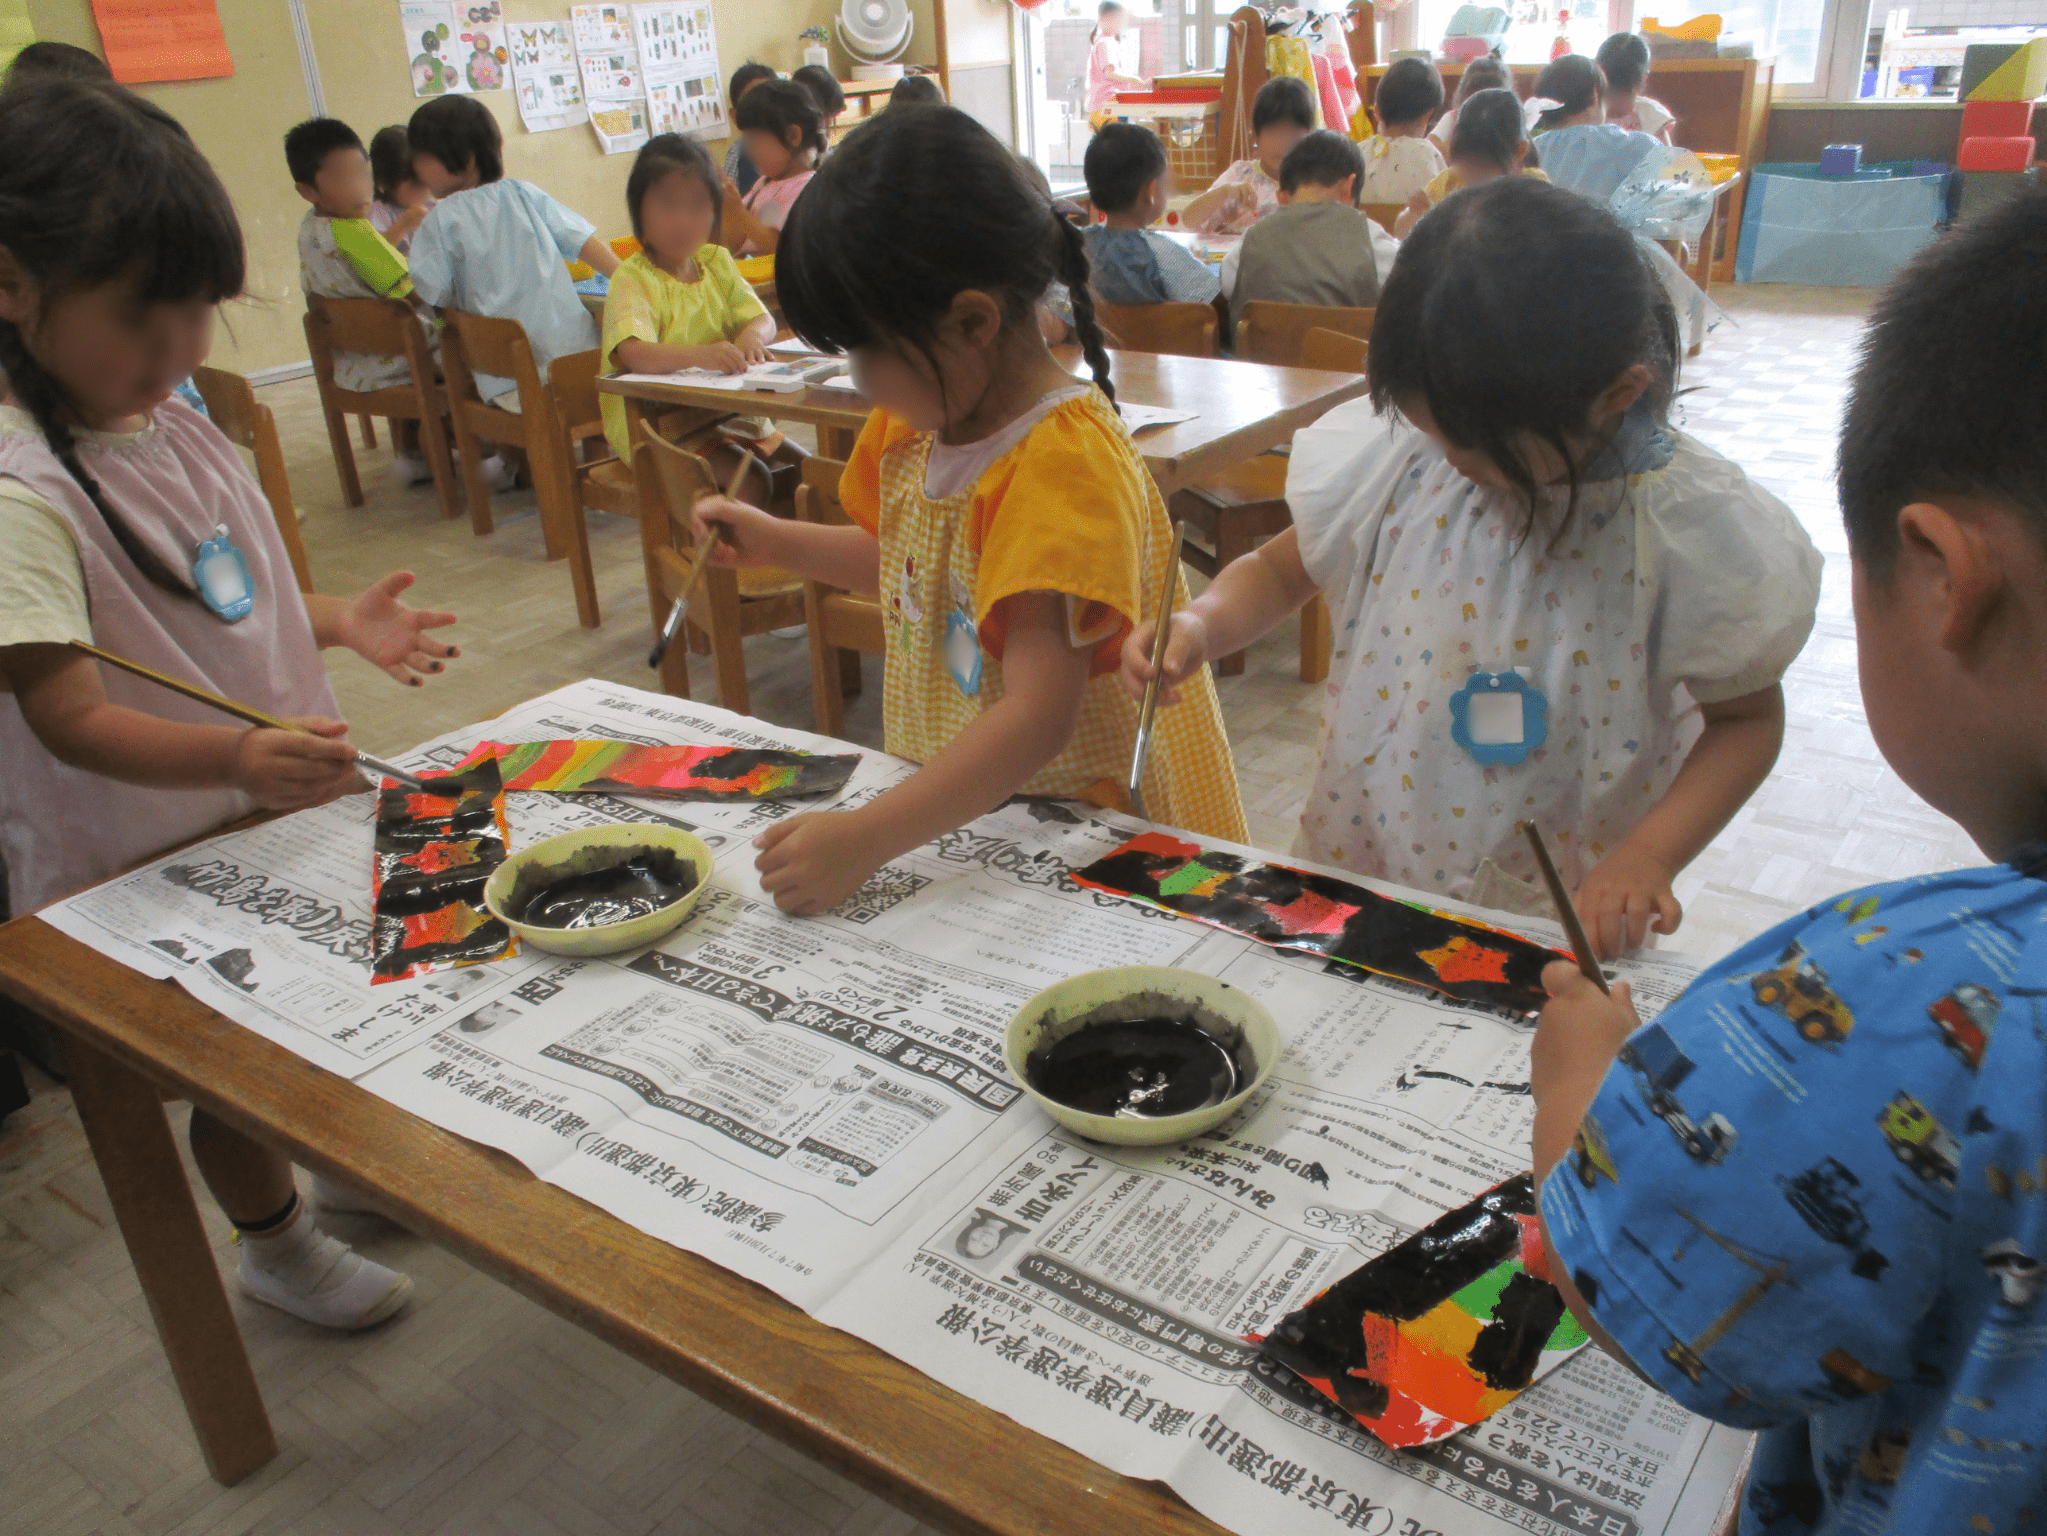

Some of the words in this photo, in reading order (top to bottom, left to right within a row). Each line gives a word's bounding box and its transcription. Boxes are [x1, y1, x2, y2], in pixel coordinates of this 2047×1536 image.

[508, 961, 587, 1005] 西みゆか
[751, 964, 786, 981] 3
[331, 993, 421, 1043] たけしま
[402, 1003, 443, 1026] 市川
[651, 953, 900, 1054] 誰もが挑戦できる日本へ。
[872, 1002, 908, 1024] 2
[877, 1079, 911, 1098] 社民党
[899, 1046, 1017, 1107] 国民民主党
[420, 1057, 787, 1236] 参議院(東京都選出)議員選挙選挙公報
[986, 1160, 1045, 1207] 無所属
[1014, 1157, 1097, 1224] 吉永アイ
[724, 1228, 813, 1277] 令和7年7月20日執行
[912, 1250, 1035, 1314] 東京都選挙管理委員会
[1241, 1245, 1320, 1337] 外国人政策の推進
[1484, 1431, 1645, 1510] 法律は人を救う
